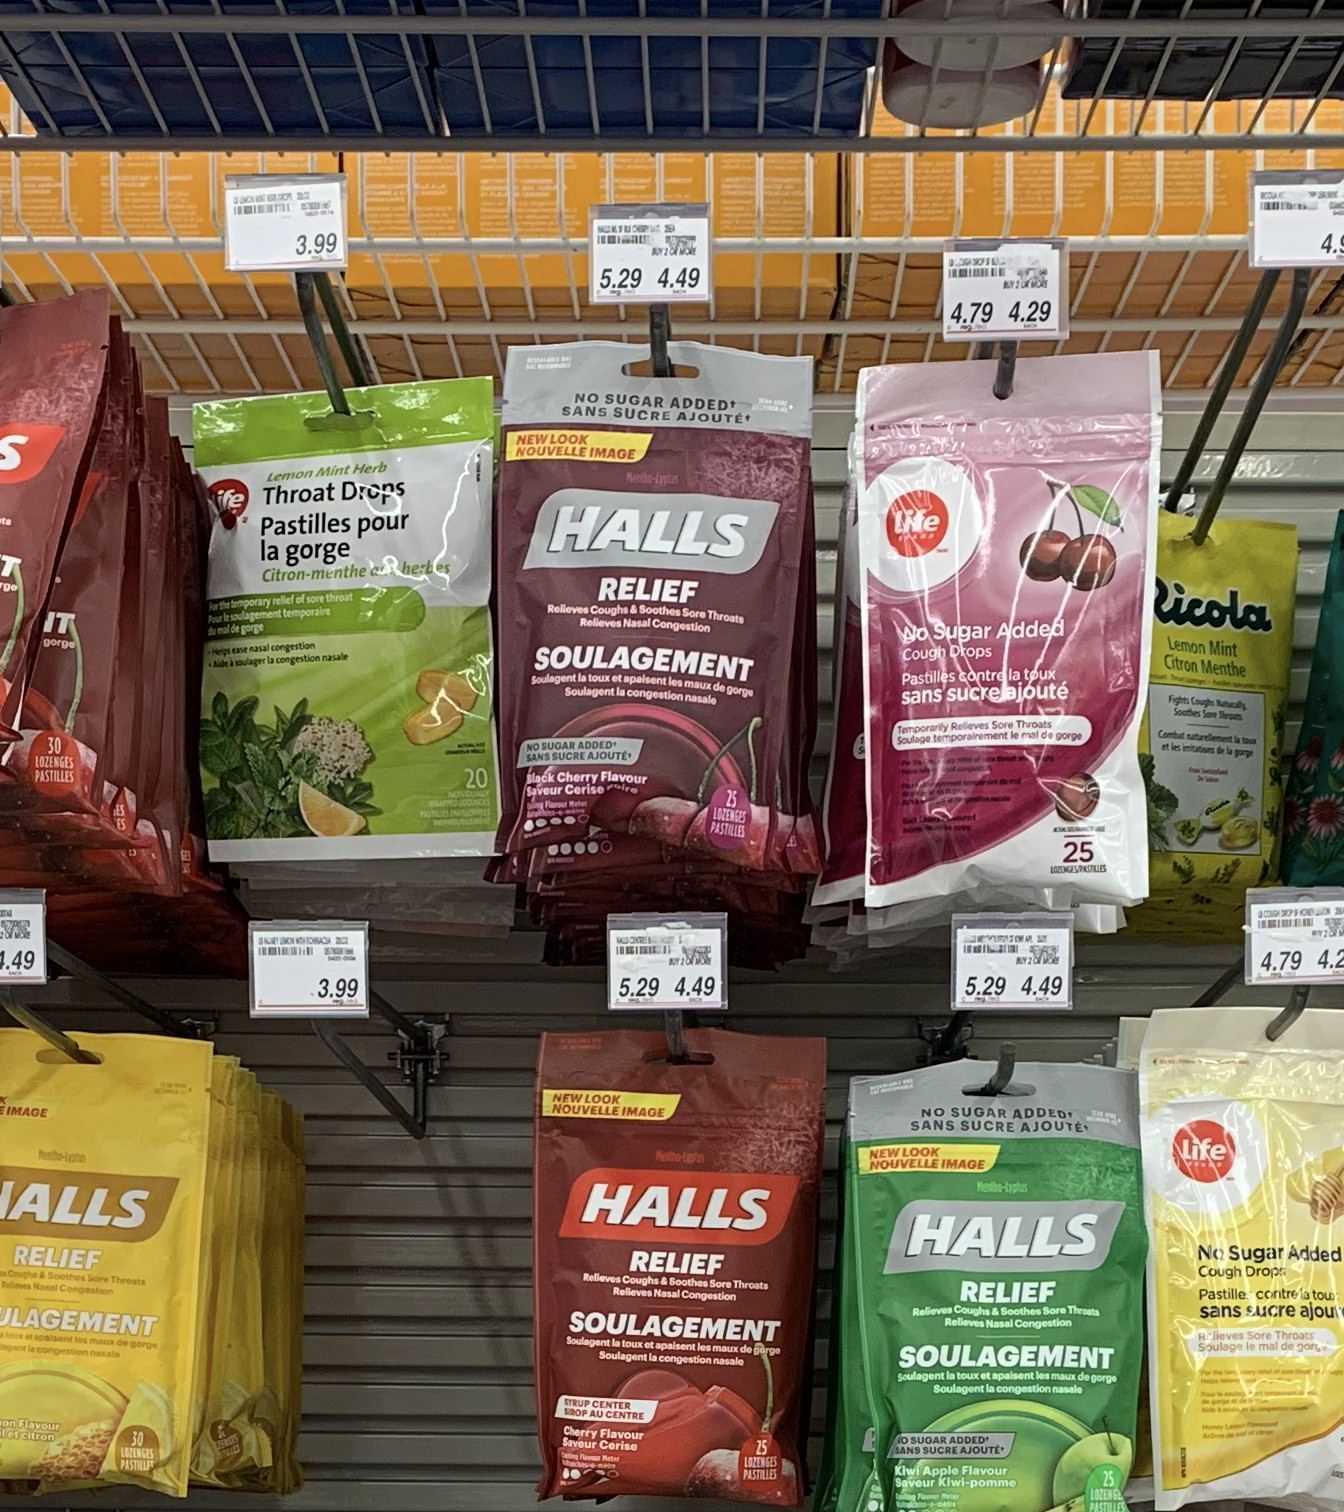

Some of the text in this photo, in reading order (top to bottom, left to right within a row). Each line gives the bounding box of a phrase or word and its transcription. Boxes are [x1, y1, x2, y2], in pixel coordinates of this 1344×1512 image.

[599, 268, 700, 289] 5.29 4.49
[951, 301, 1050, 324] 4.79 4.29
[263, 479, 406, 505] Throat Drops
[260, 511, 410, 536] Pastilles pour
[550, 505, 748, 558] HALLS
[260, 541, 350, 567] la gorge
[598, 577, 699, 603] RELIEF
[547, 604, 744, 624] Relieves Coughs & Soothes Sore Throats
[902, 618, 1064, 644] No Sugar Added
[1168, 637, 1237, 657] Lemon Mint
[1164, 656, 1246, 678] Citron Menthe
